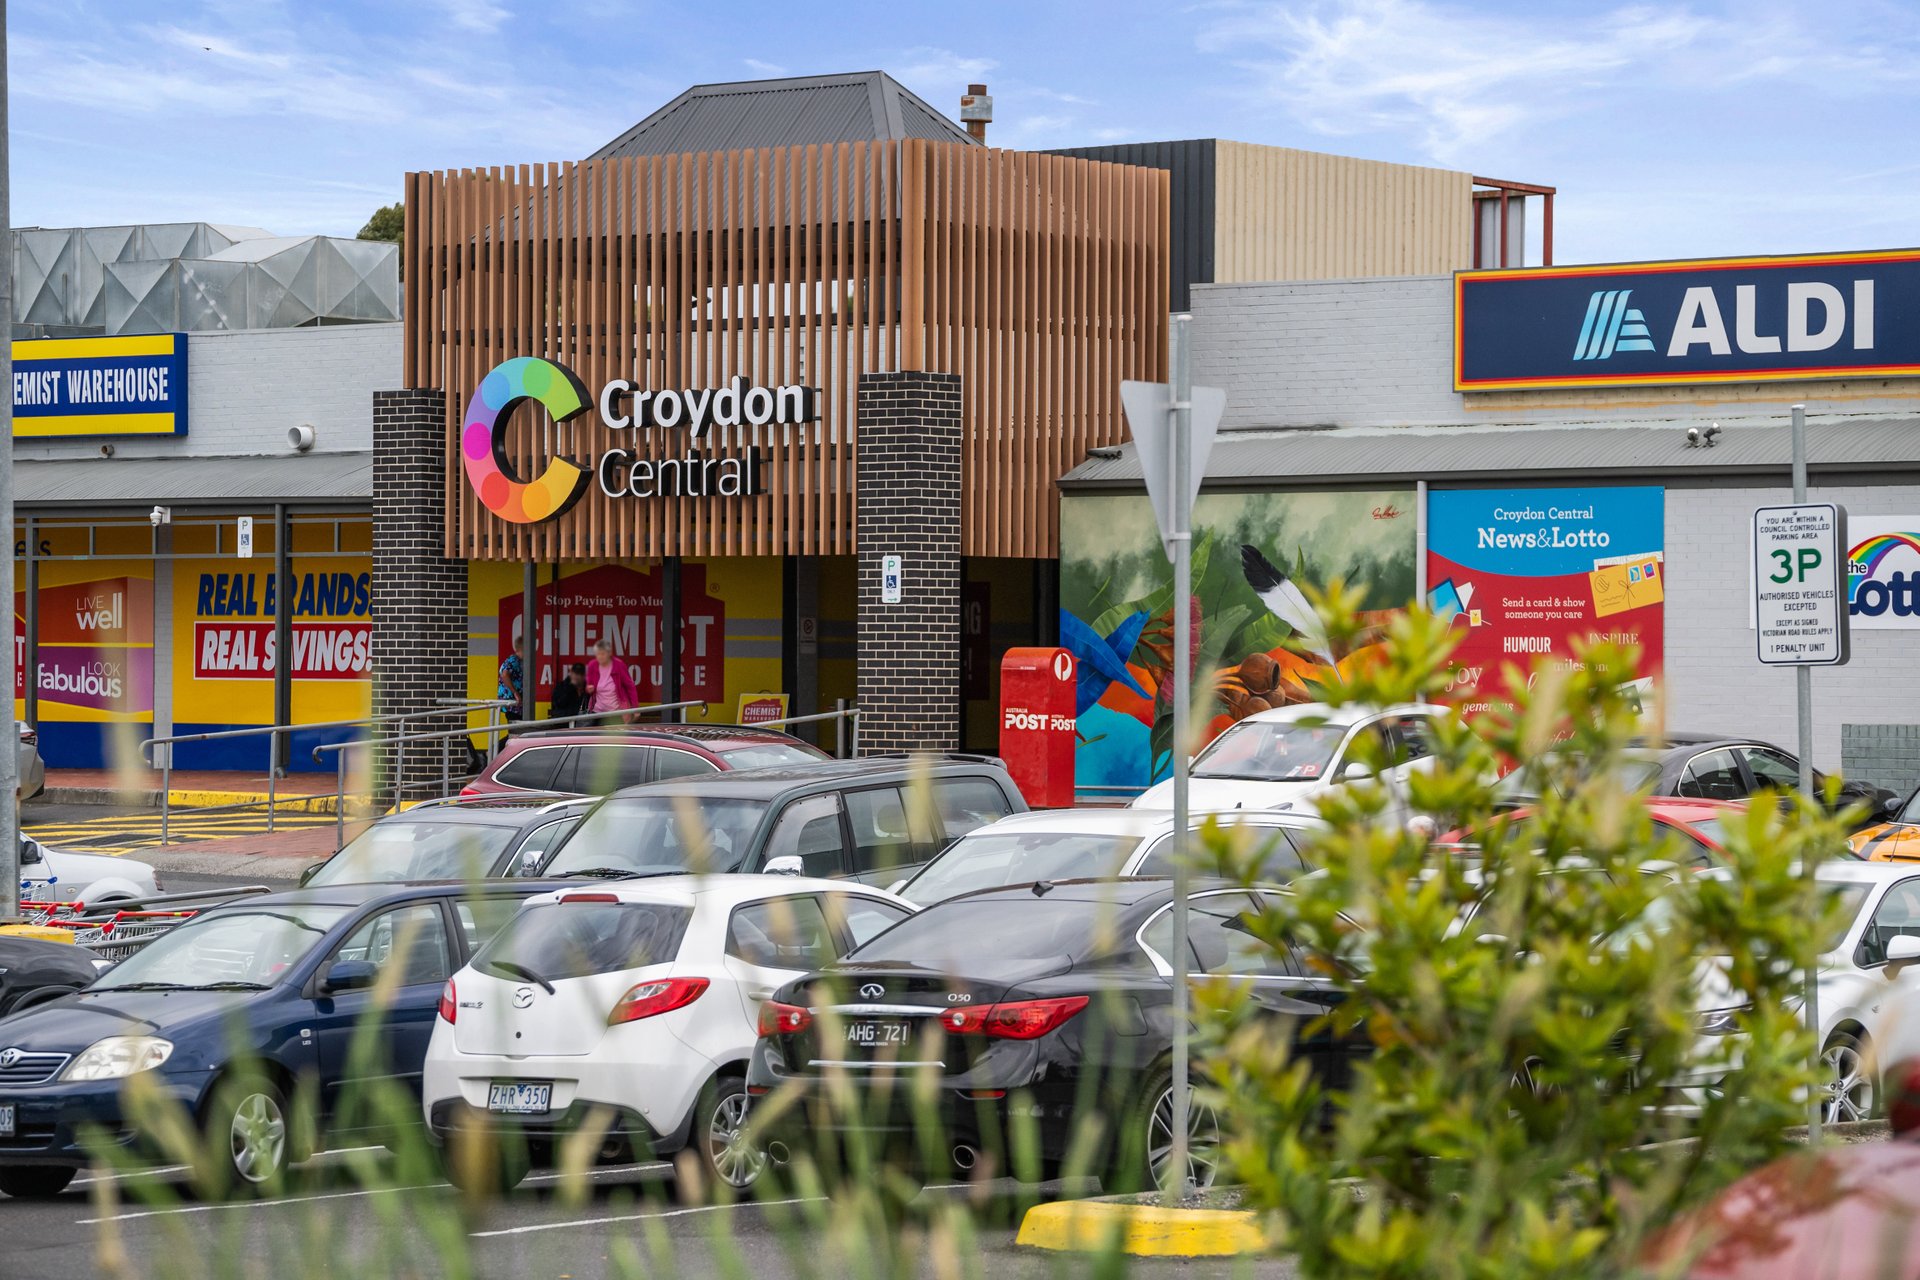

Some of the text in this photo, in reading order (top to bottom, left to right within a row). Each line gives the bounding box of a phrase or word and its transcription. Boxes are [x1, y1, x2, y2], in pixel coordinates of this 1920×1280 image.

[1667, 279, 1874, 356] ALDI
[67, 367, 168, 403] WAREHOUSE
[600, 375, 806, 438] Croydon
[599, 445, 753, 498] Central
[1494, 505, 1593, 523] Croydon Central
[1782, 516, 1794, 524] ARE
[1790, 524, 1830, 532] CONTROLLED
[1770, 548, 1822, 584] 3P
[197, 573, 258, 616] REAL
[546, 595, 571, 608] Stop
[574, 595, 614, 608] Paying
[615, 596, 637, 606] Too
[1502, 597, 1524, 607] Send
[1533, 597, 1552, 607] card
[1554, 598, 1561, 607] &
[1562, 597, 1585, 607] show
[1760, 590, 1834, 600] AUTHORISED VEHICLES
[76, 595, 104, 611] LIVE
[76, 592, 122, 630] well
[1784, 602, 1817, 611] EXCEPTED
[1545, 611, 1562, 620] you
[1802, 618, 1818, 626] SIGNED
[1503, 636, 1551, 652] HUMOUR
[1590, 632, 1639, 645] INSPIRE
[201, 630, 372, 672] REAL SVINGS!
[1776, 644, 1806, 653] PENALTY
[1809, 643, 1825, 651] UNIT
[87, 661, 121, 677] LOOK
[1444, 660, 1483, 692] joy
[38, 663, 121, 698] fabulous
[744, 707, 781, 715] CHEMIST
[1005, 714, 1048, 730] POST
[1051, 719, 1076, 730] POST
[491, 1087, 547, 1104] ZHR 350
